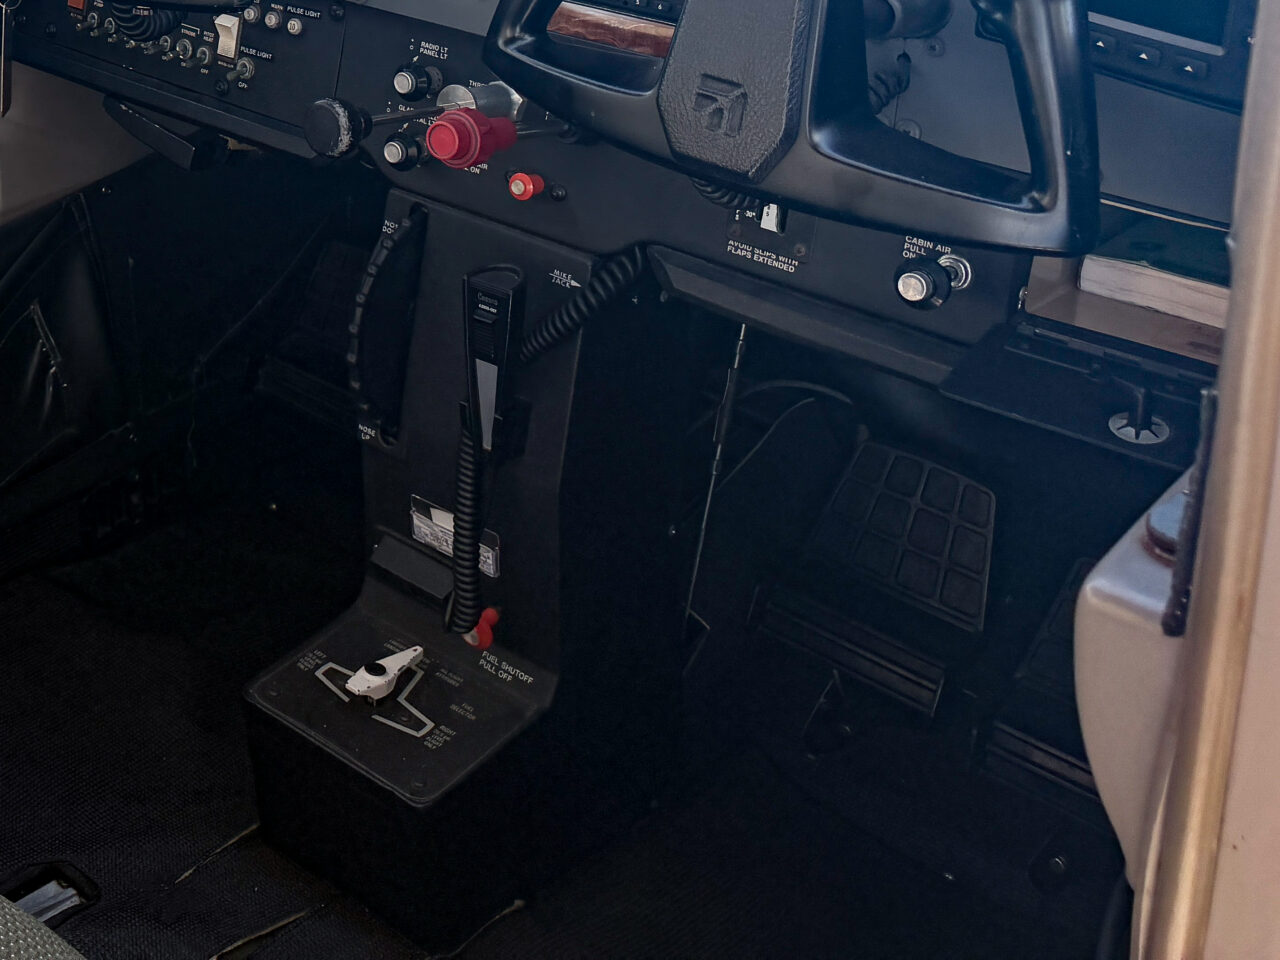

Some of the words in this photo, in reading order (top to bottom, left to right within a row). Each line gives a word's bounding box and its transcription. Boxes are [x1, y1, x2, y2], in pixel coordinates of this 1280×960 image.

[287, 6, 304, 14] PULSE
[305, 10, 320, 18] LIGHT
[421, 41, 439, 51] RADIO
[241, 46, 257, 56] PULSE
[257, 50, 273, 60] LIGHT
[420, 48, 439, 58] PANEL
[904, 244, 927, 257] PULL
[906, 236, 933, 250] CABIN
[935, 244, 952, 255] AIR
[727, 246, 752, 259] FLAPS
[754, 254, 795, 273] EXTENDED
[902, 250, 916, 259] ON
[553, 269, 572, 280] MIKE
[552, 277, 571, 289] JACK
[358, 424, 376, 437] NOSE
[479, 659, 497, 675] PULL
[497, 669, 513, 683] OFF
[482, 650, 499, 666] FUEL
[501, 662, 534, 685] SHUTOFF
